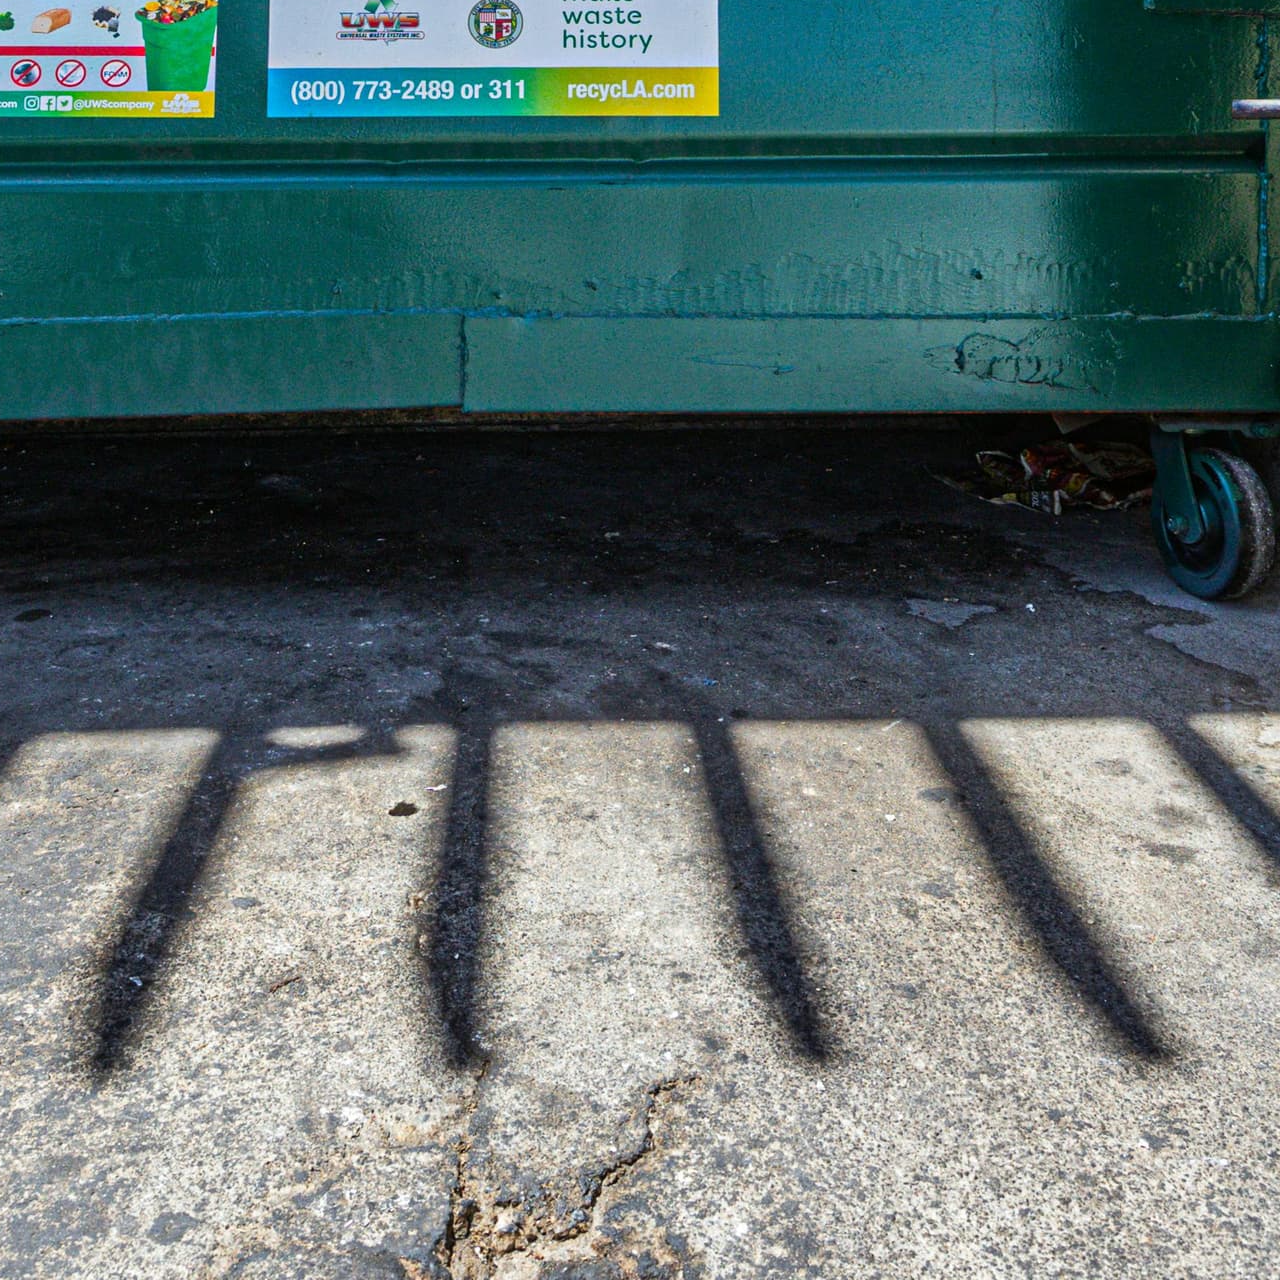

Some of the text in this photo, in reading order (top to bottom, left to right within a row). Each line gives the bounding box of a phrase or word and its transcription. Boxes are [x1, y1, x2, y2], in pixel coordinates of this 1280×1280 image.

[339, 11, 420, 28] UWS
[562, 8, 642, 25] waste
[562, 29, 653, 54] history
[291, 80, 525, 104] (800) 773-2489 or 311
[567, 81, 695, 102] recycLA.com
[73, 98, 155, 111] @UWScompany
